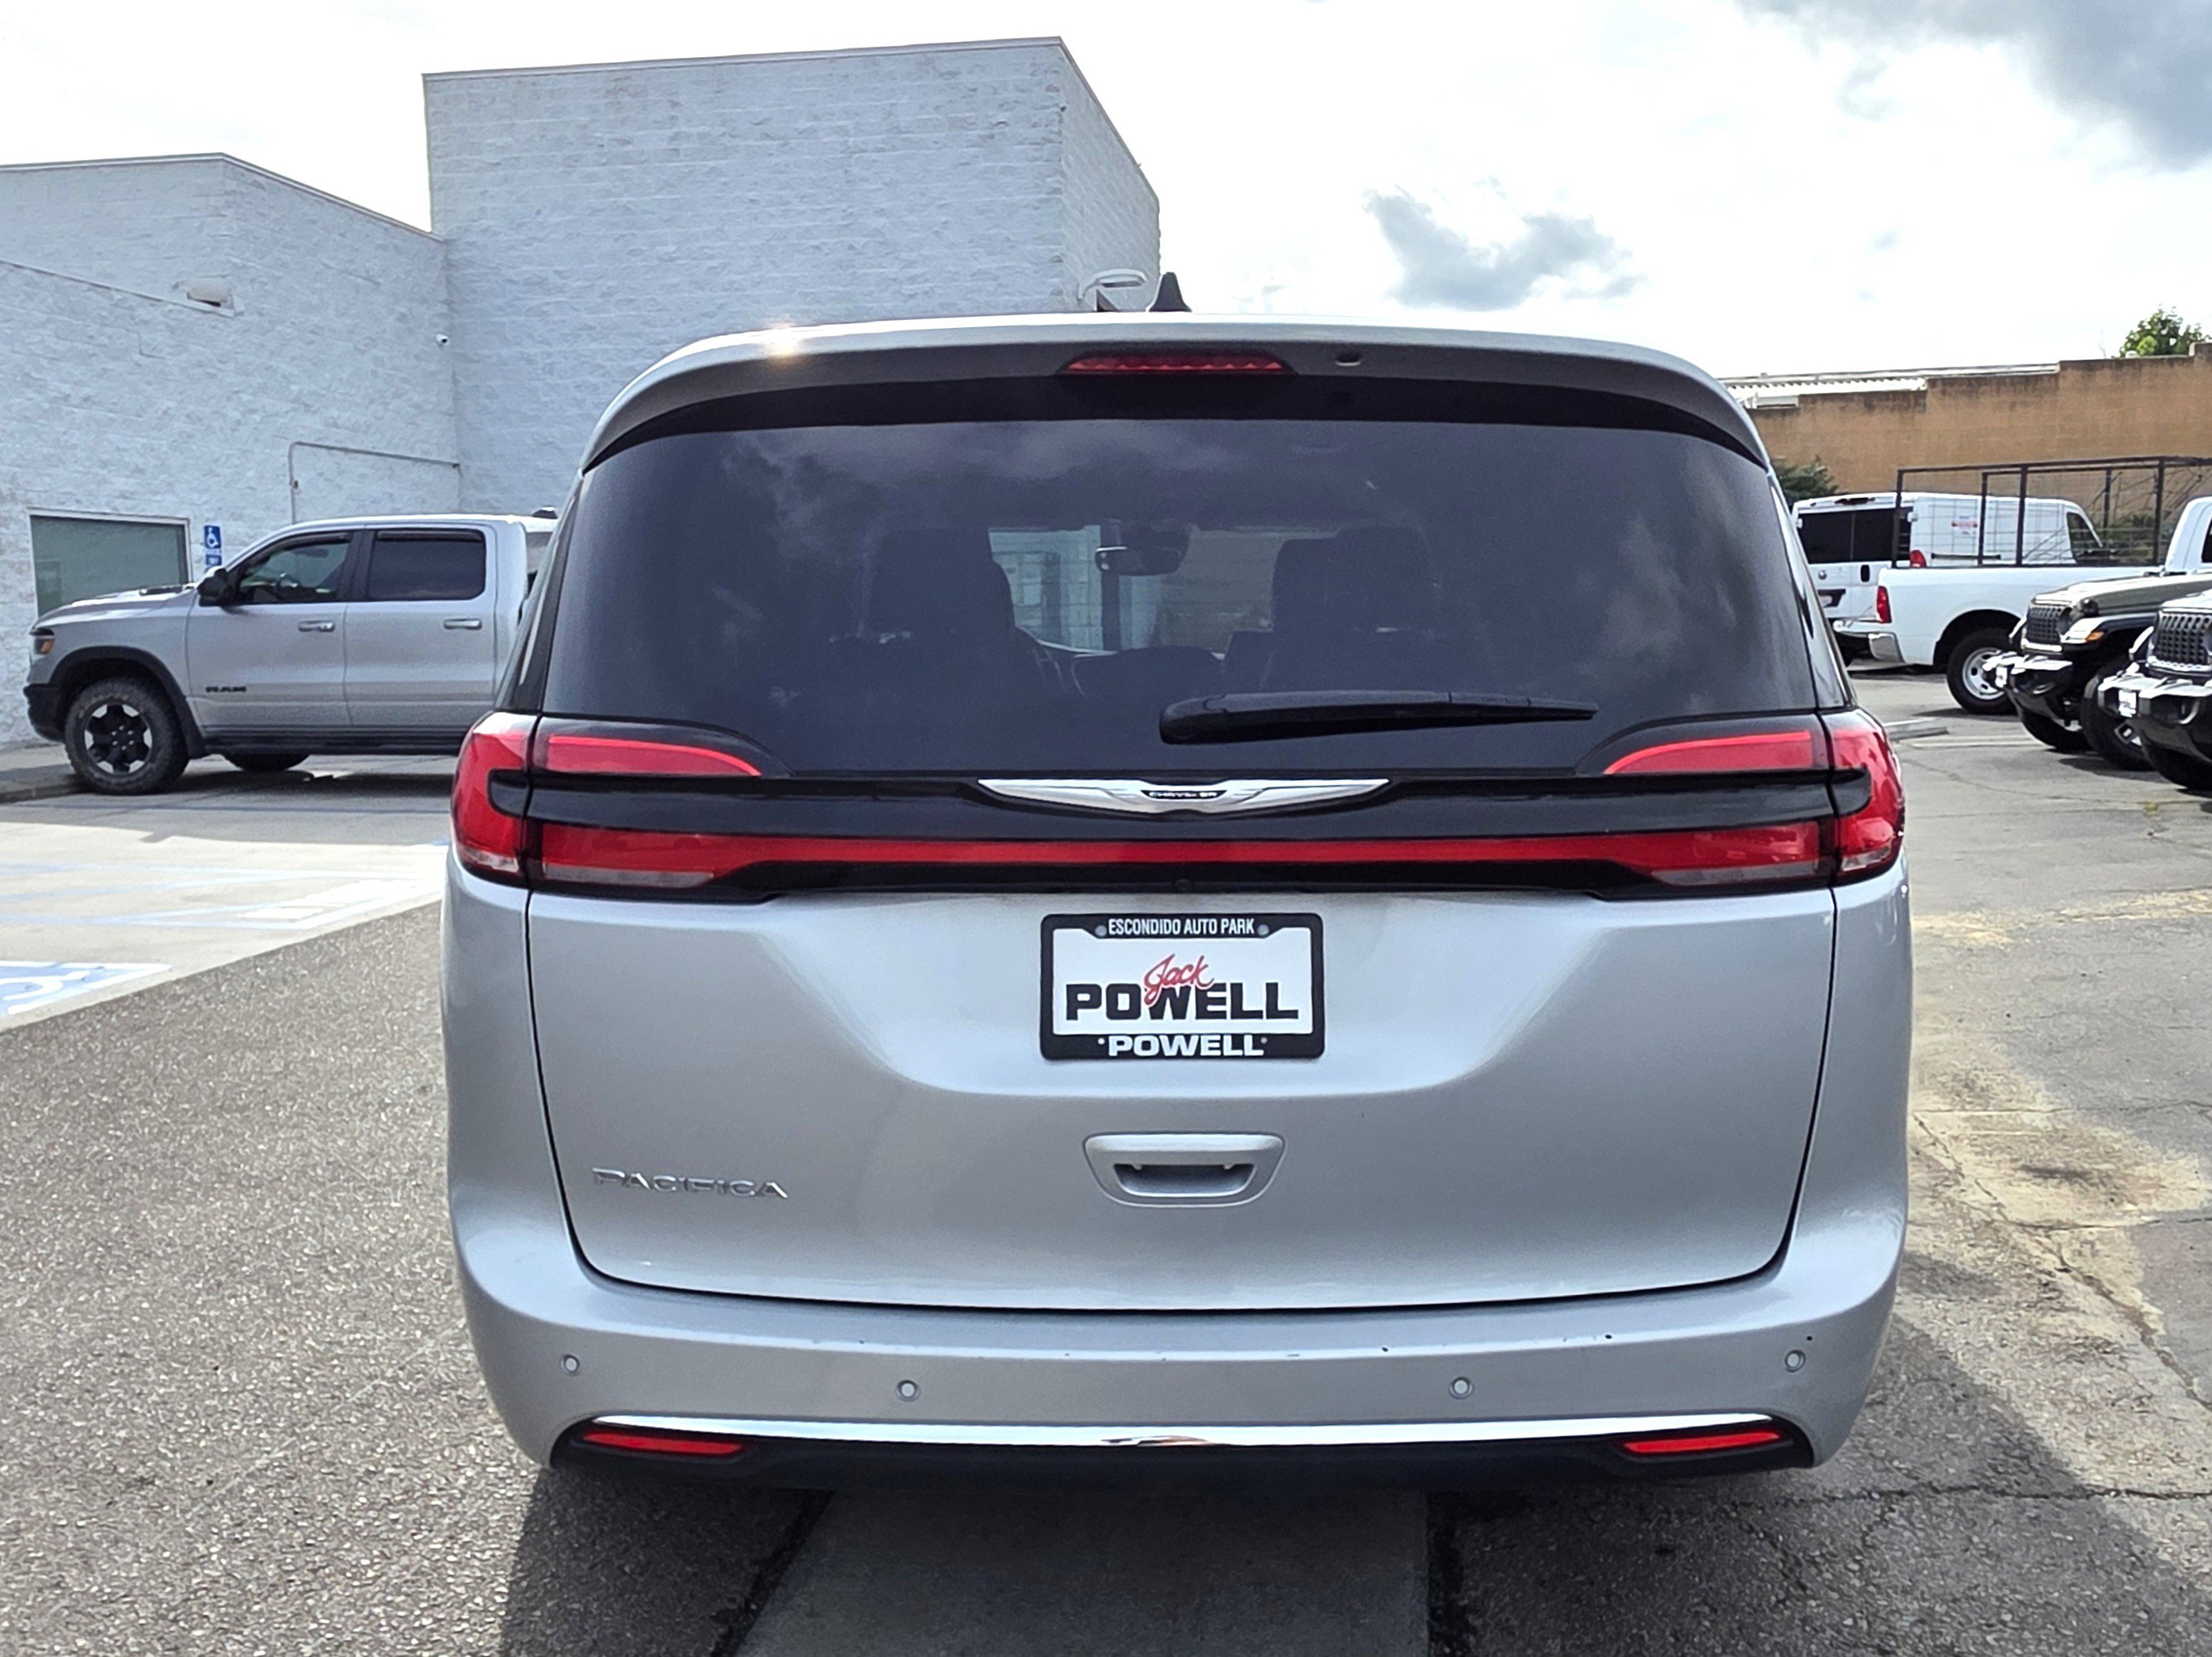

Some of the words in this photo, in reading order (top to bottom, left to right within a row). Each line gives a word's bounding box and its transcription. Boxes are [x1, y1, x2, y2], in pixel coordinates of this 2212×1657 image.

[1109, 919, 1180, 935] ESCONDIDO
[1184, 919, 1217, 935] AUTO
[1221, 919, 1255, 935] PARK
[1144, 954, 1215, 1006] Jack
[1066, 982, 1299, 1021] POWELL
[1109, 1035, 1264, 1057] POWELL
[592, 1168, 788, 1199] PACIFICA
